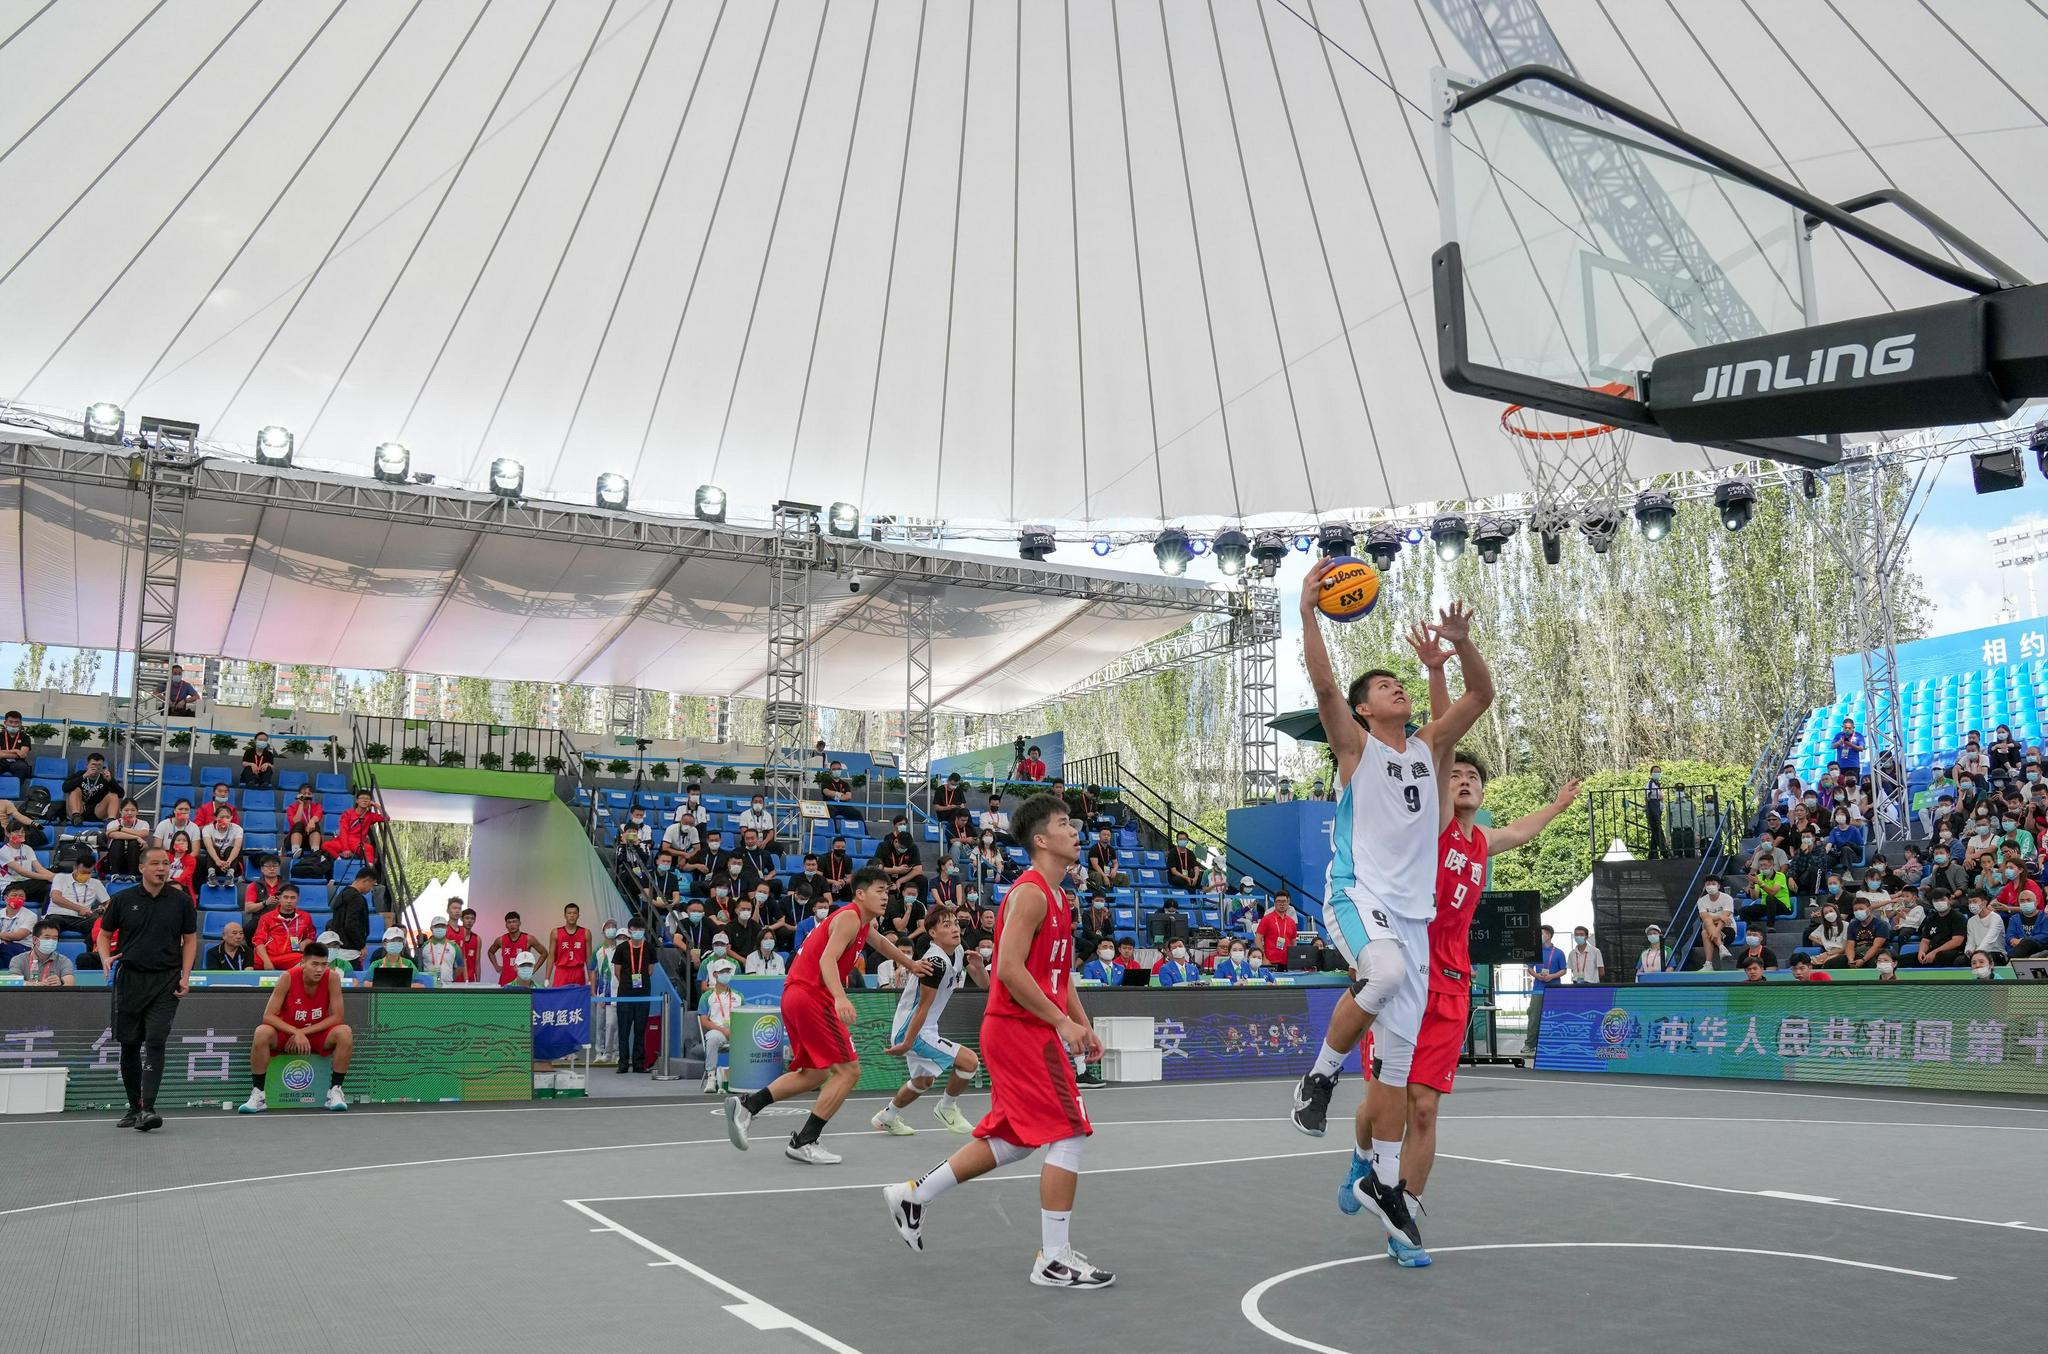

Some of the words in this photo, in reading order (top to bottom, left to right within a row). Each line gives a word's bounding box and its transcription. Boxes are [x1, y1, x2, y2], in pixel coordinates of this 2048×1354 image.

[1692, 333, 1916, 401] JINLING
[1982, 630, 2046, 667] 相约
[1387, 760, 1430, 782] 福建
[1404, 785, 1421, 813] 9
[1444, 847, 1483, 887] 陕西
[1450, 882, 1469, 909] 9
[1371, 909, 1390, 929] 9
[1511, 916, 1523, 926] 11
[294, 1007, 322, 1021] 陕西
